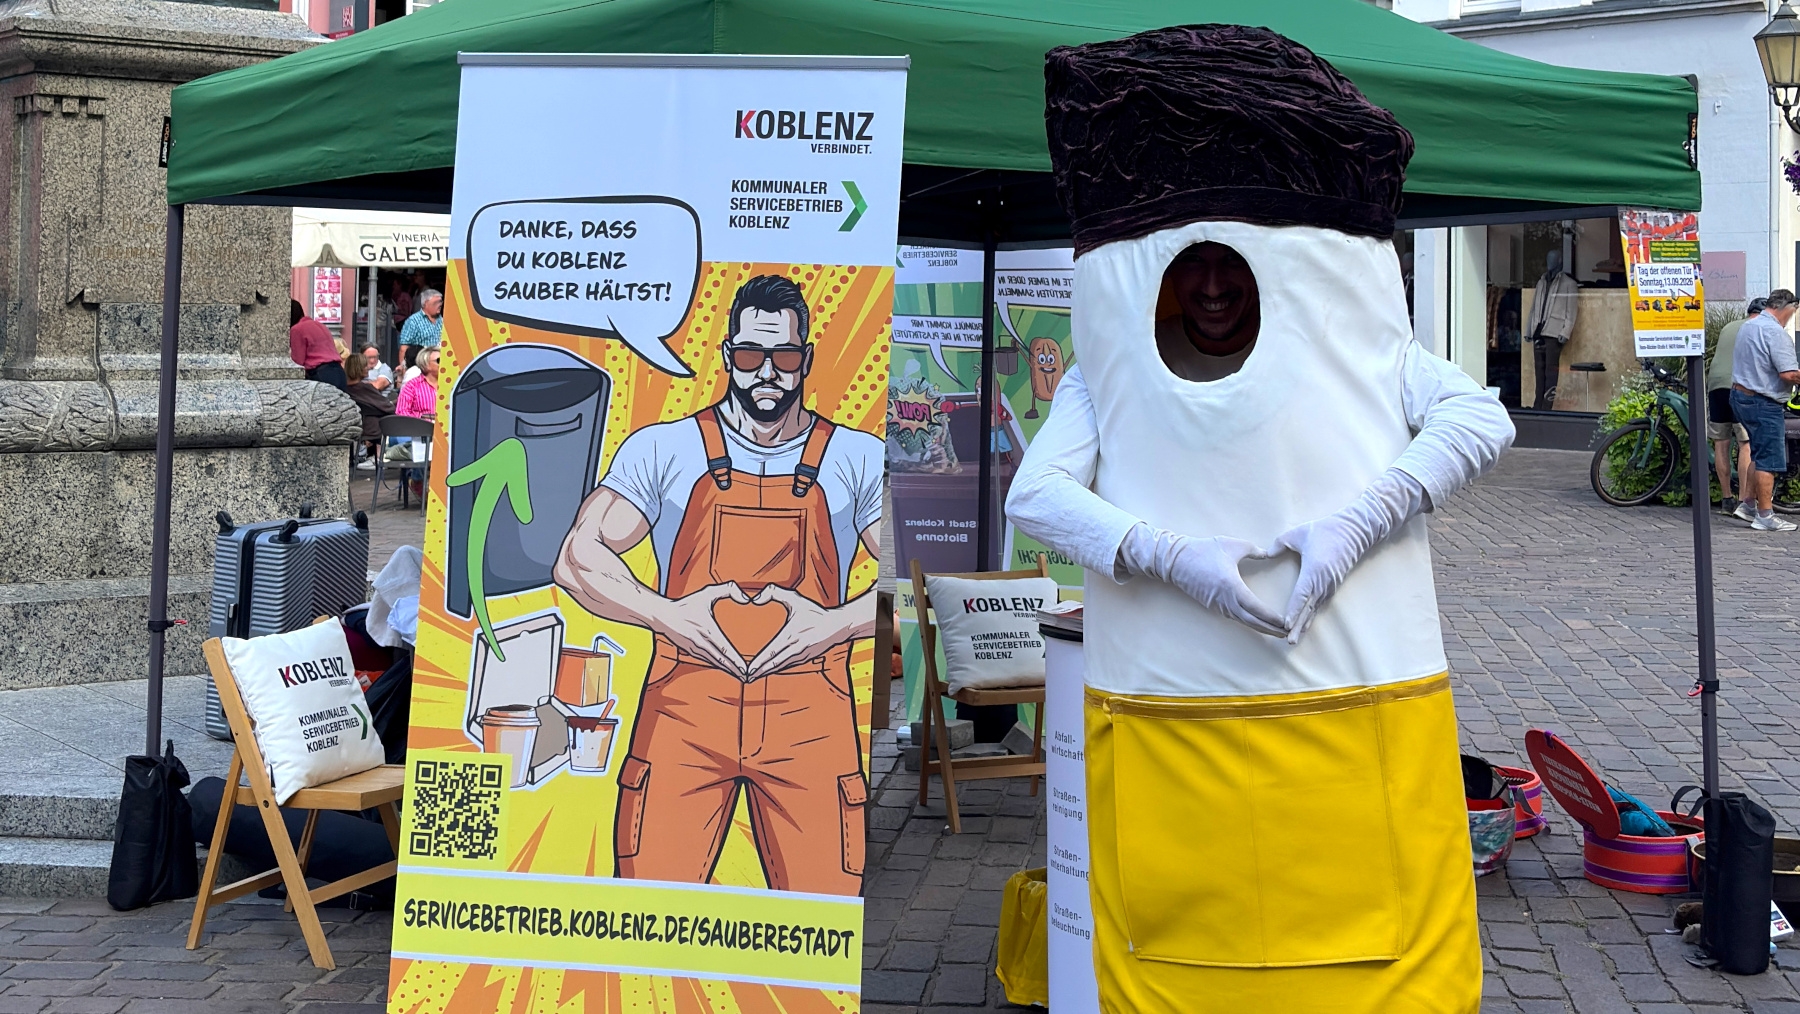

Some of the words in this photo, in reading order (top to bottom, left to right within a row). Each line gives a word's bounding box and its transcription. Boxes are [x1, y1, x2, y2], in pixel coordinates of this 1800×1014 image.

[735, 110, 875, 141] KOBLENZ
[810, 143, 873, 155] VERBINDET.
[731, 180, 828, 196] KOMMUNALER
[730, 197, 844, 214] SERVICEBETRIEB
[499, 219, 573, 241] DANKE,
[580, 220, 638, 240] DASS
[729, 214, 791, 230] KOBLENZ
[497, 251, 528, 270] DU
[531, 251, 628, 271] KOBLENZ
[1638, 267, 1648, 276] Tag
[1650, 267, 1659, 275] der
[1660, 266, 1682, 275] offenen
[1683, 266, 1692, 274] Tür
[494, 281, 580, 302] SAUBER
[585, 279, 672, 303] HÄLTST!
[963, 597, 1044, 614] KOBLENZ
[971, 631, 1031, 642] KOMMUNALER
[973, 641, 1042, 651] SERVICEBETRIEB
[975, 651, 1013, 660] KOBLENZ
[278, 656, 348, 688] KOBLENZ
[299, 706, 349, 727] KOMMUNALER
[302, 717, 360, 740] SERVICEBETRIEB
[306, 735, 339, 753] KOBLENZ
[1054, 731, 1076, 745] Abfall-
[1051, 745, 1084, 761] wirtschaft
[1053, 787, 1081, 804] Straßen-
[1052, 803, 1083, 822] reinigung
[1053, 845, 1081, 862] Straßen-
[1054, 903, 1082, 920] Straßen-
[403, 898, 856, 959] SERVICEBETRIEB.KOBLENZ.DE/SAUBERESTADT
